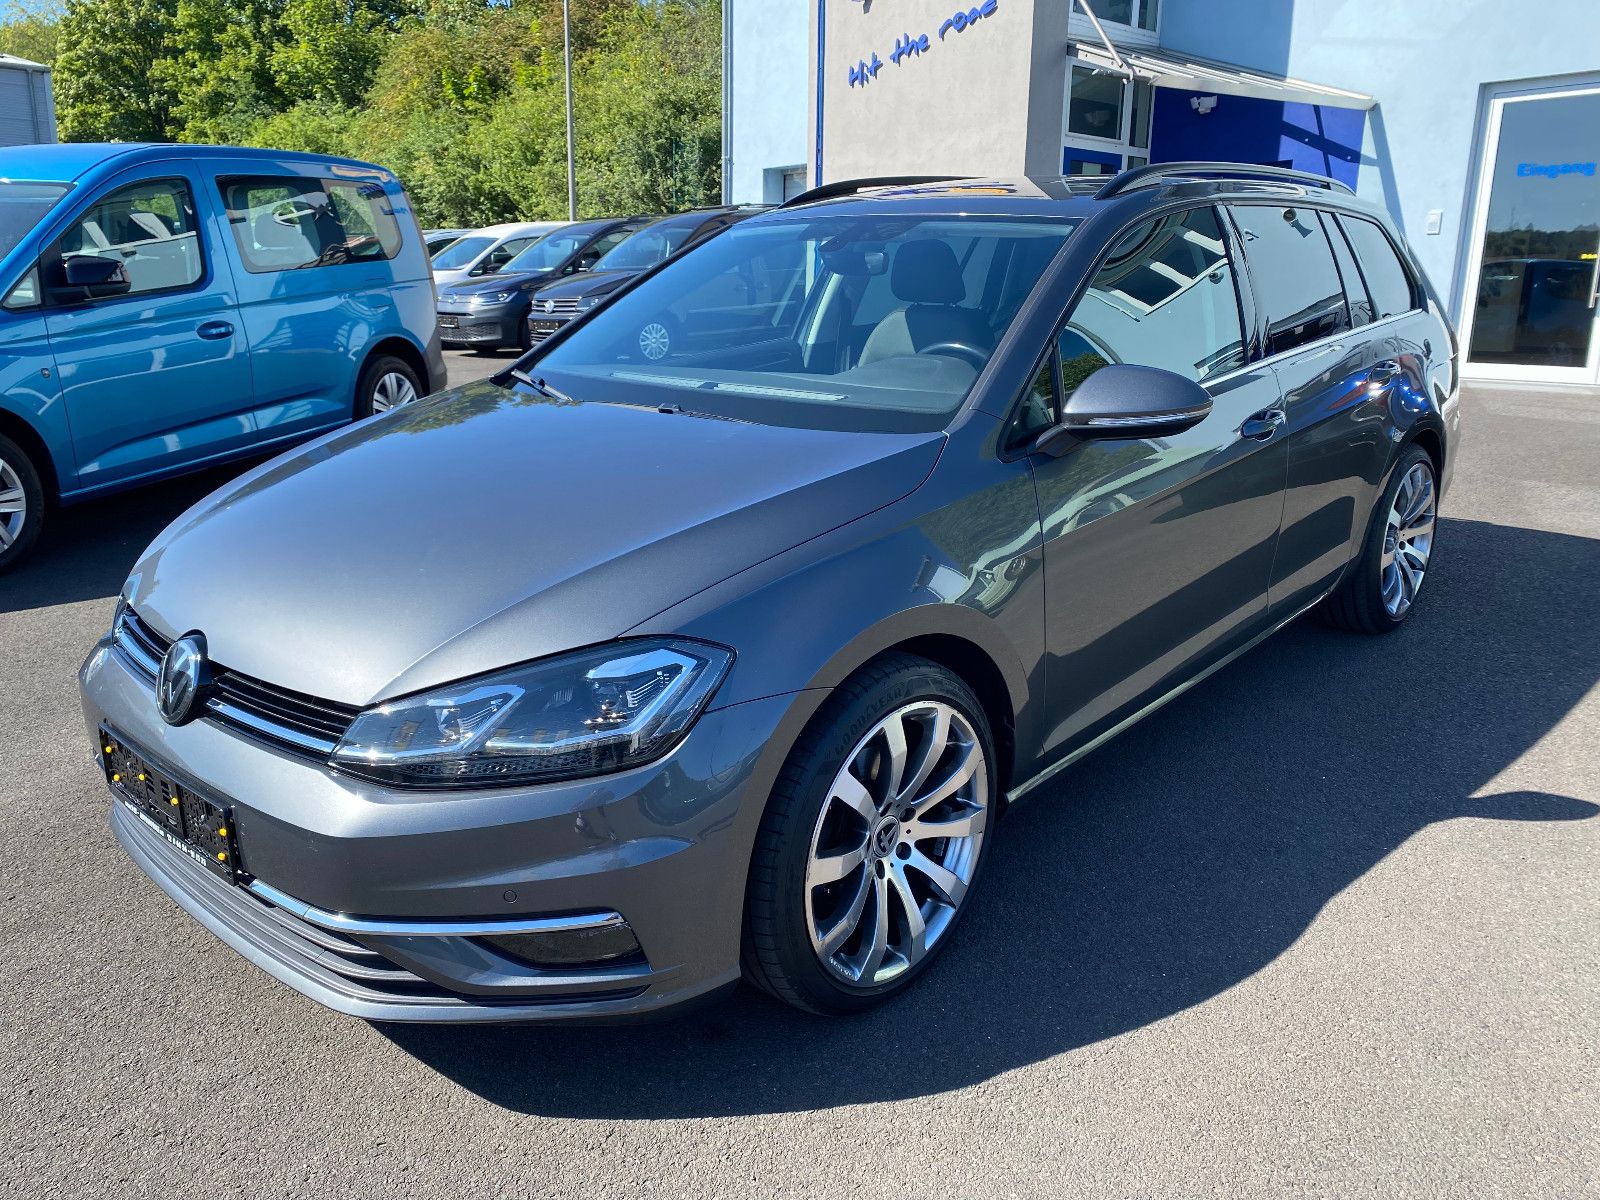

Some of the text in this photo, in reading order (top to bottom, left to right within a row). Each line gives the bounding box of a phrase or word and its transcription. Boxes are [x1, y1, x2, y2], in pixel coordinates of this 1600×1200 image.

[849, 51, 882, 87] Hit
[890, 33, 928, 64] the
[1517, 162, 1596, 179] Eingang
